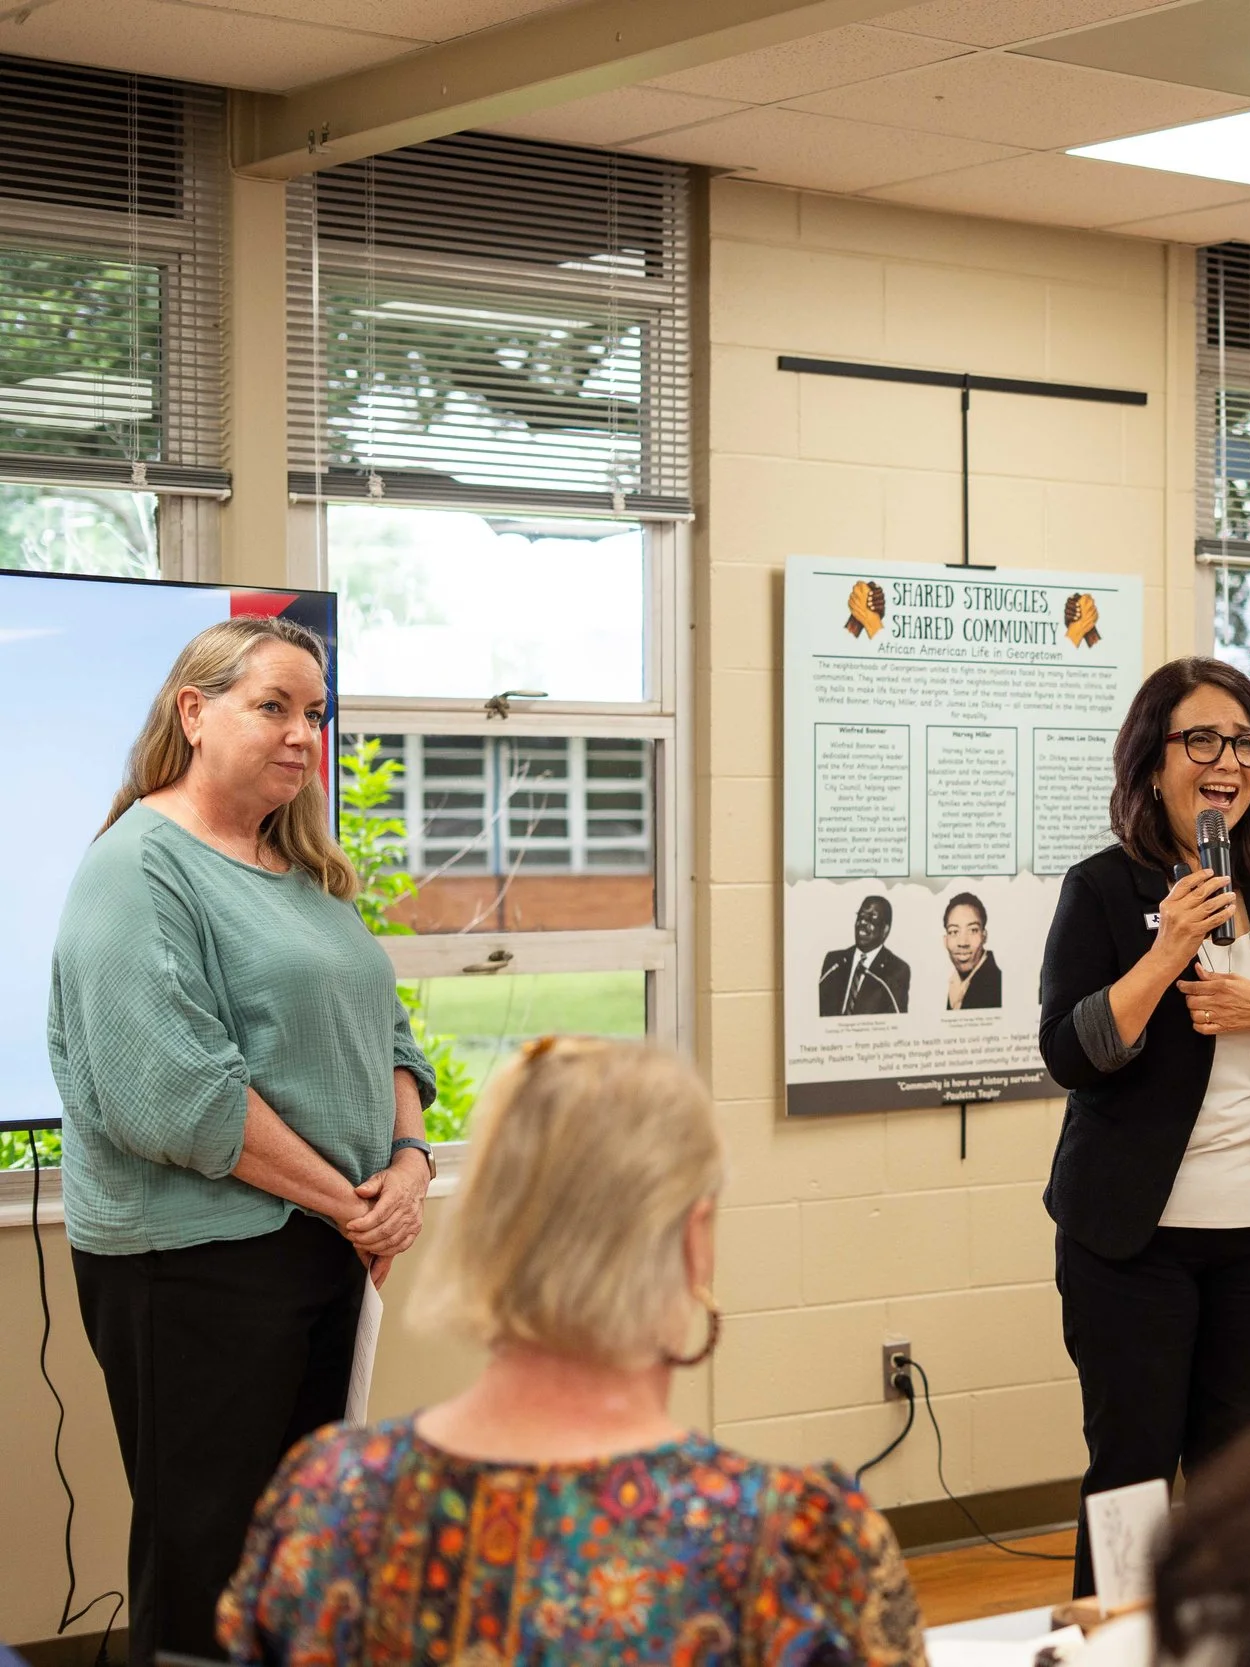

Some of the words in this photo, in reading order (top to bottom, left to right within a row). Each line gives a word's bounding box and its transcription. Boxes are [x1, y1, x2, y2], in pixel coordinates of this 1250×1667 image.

[892, 582, 955, 608] SHARED
[963, 586, 1052, 615] STRUGGLES,
[891, 615, 954, 641] SHARED
[962, 618, 1060, 645] COMMUNITY
[877, 642, 916, 656] African
[919, 644, 968, 658] American
[970, 646, 990, 659] Life
[992, 647, 1003, 659] in
[1005, 648, 1064, 663] Georgetown
[840, 726, 864, 734] Winfred
[975, 730, 992, 738] Miller
[1088, 734, 1106, 743] Dickey
[952, 1077, 967, 1087] how
[983, 1075, 1008, 1087] history
[978, 1088, 1001, 1100] Taylor
